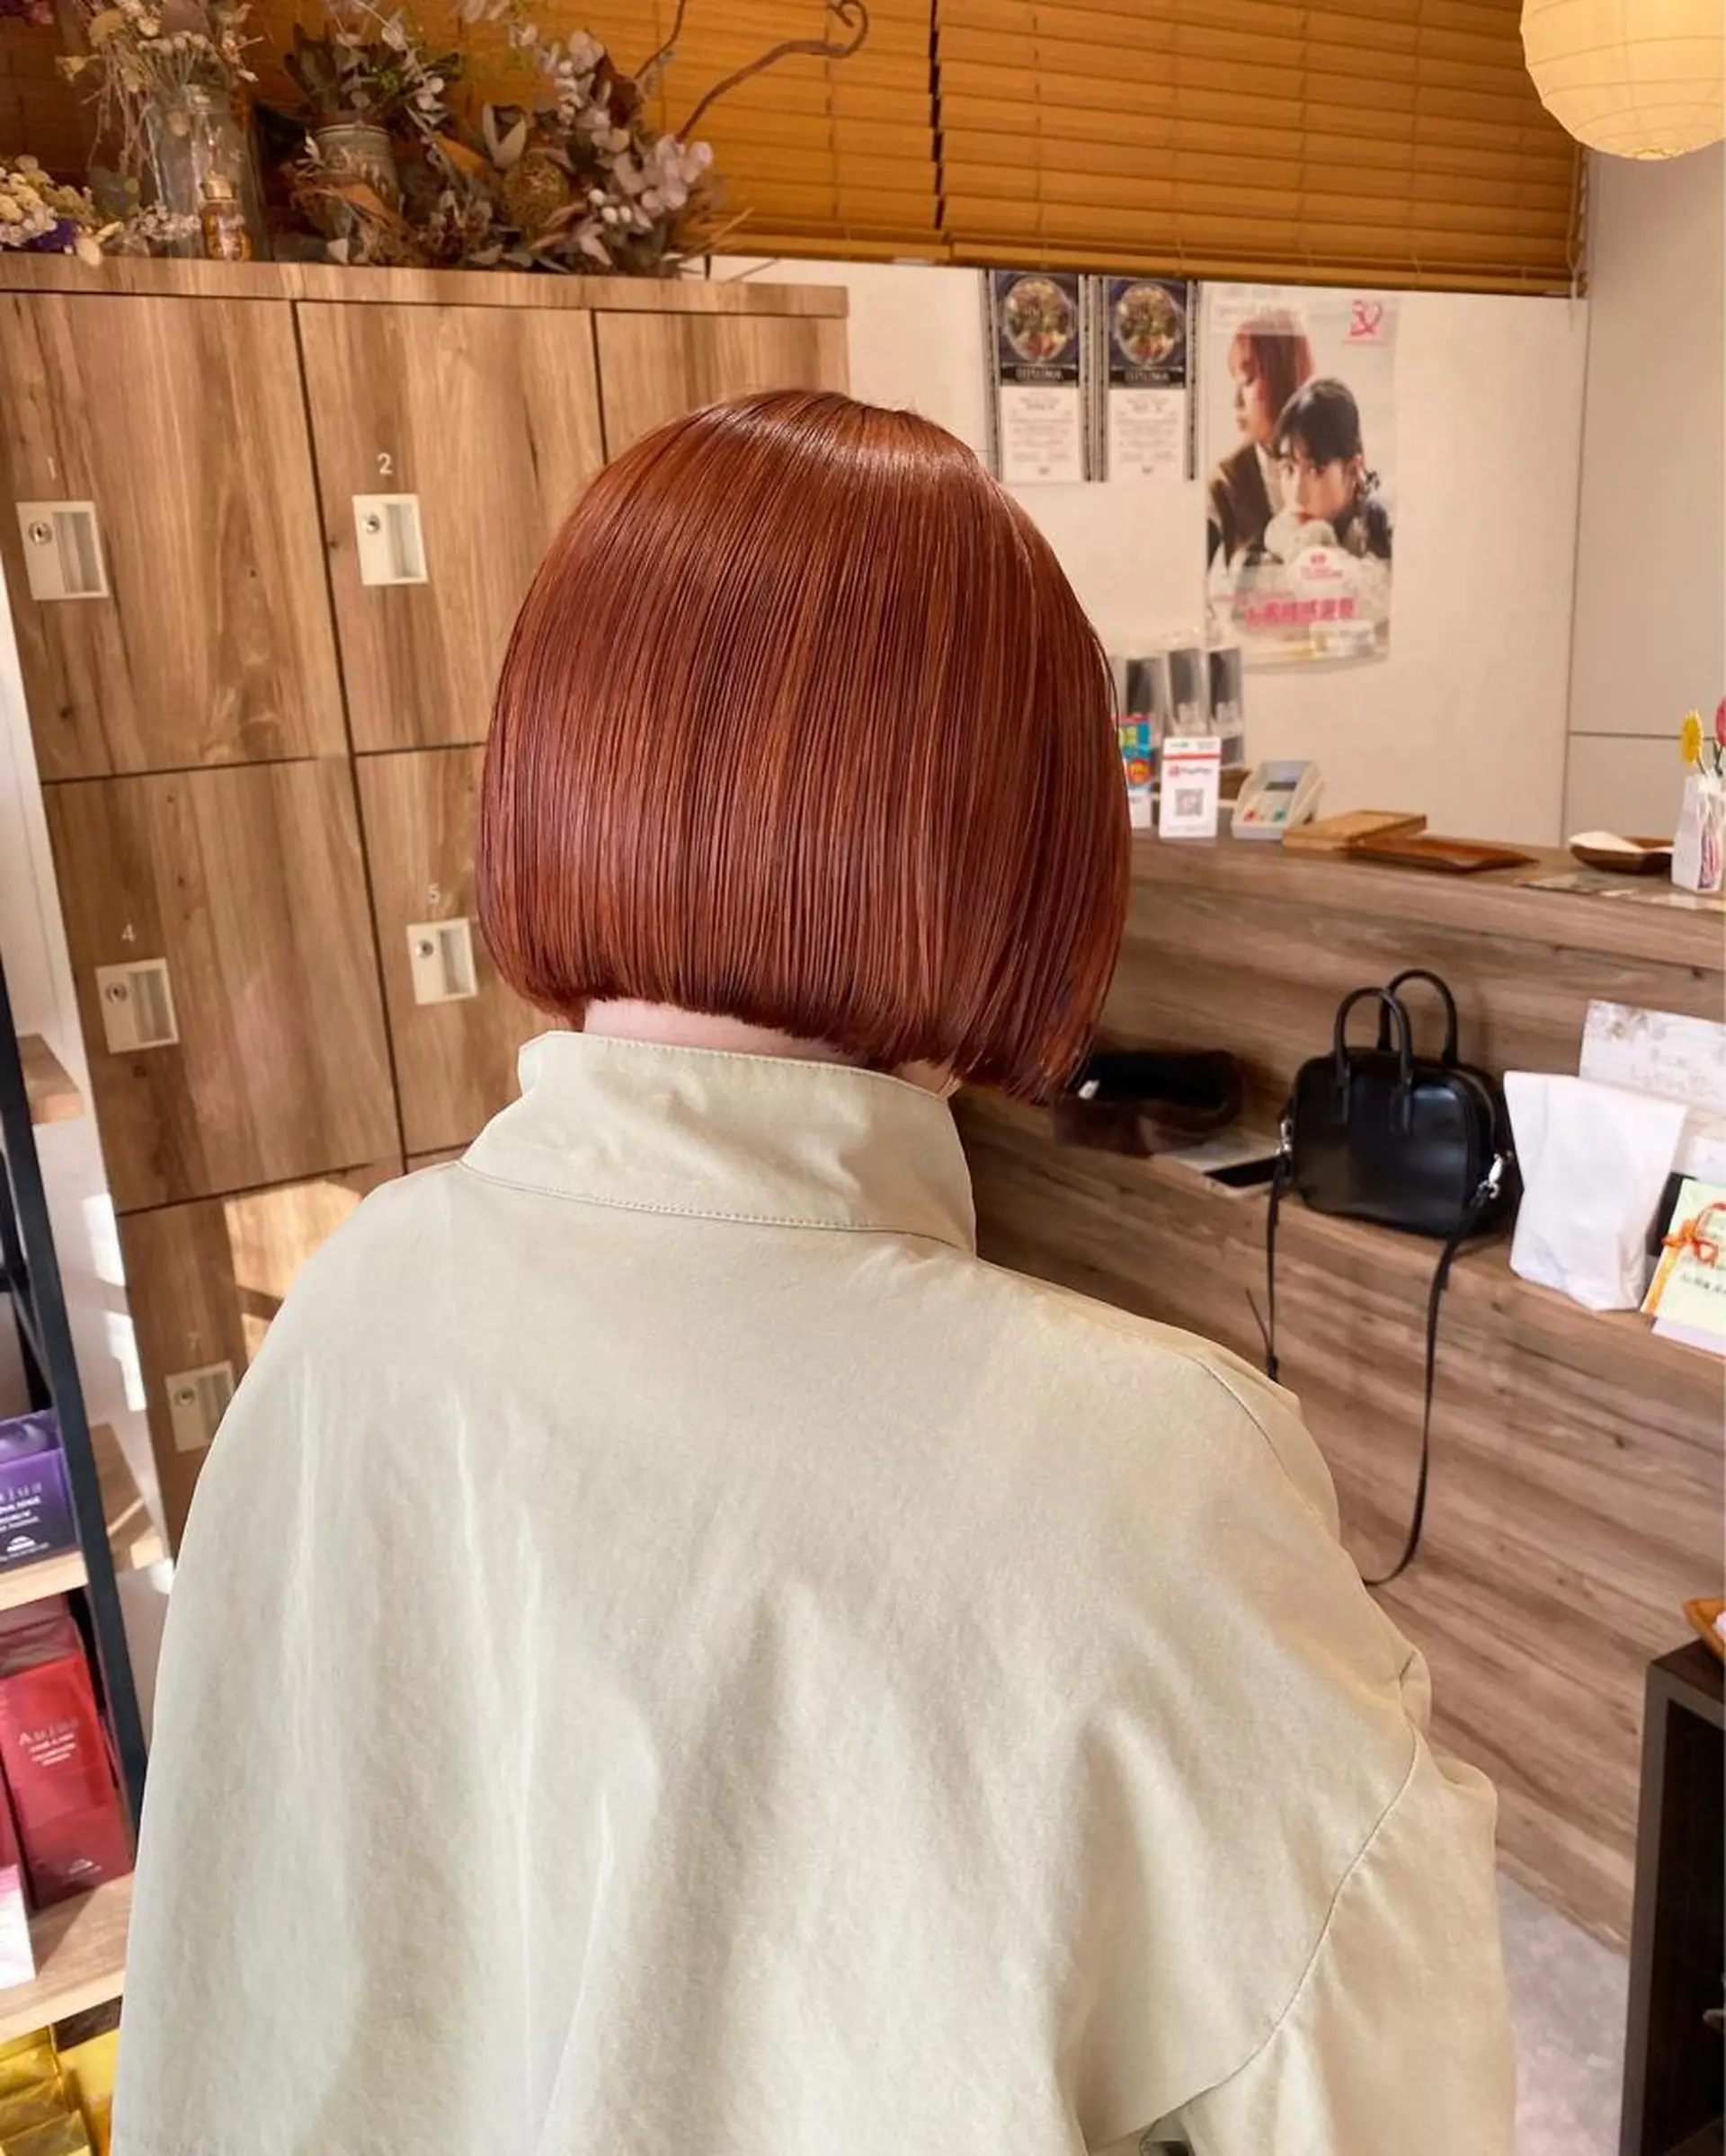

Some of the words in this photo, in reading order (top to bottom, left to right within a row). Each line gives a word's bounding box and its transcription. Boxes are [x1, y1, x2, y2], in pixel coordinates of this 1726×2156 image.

[47, 457, 57, 481] 1
[378, 452, 393, 475] 2
[428, 883, 440, 904] 5
[120, 923, 136, 943] 4
